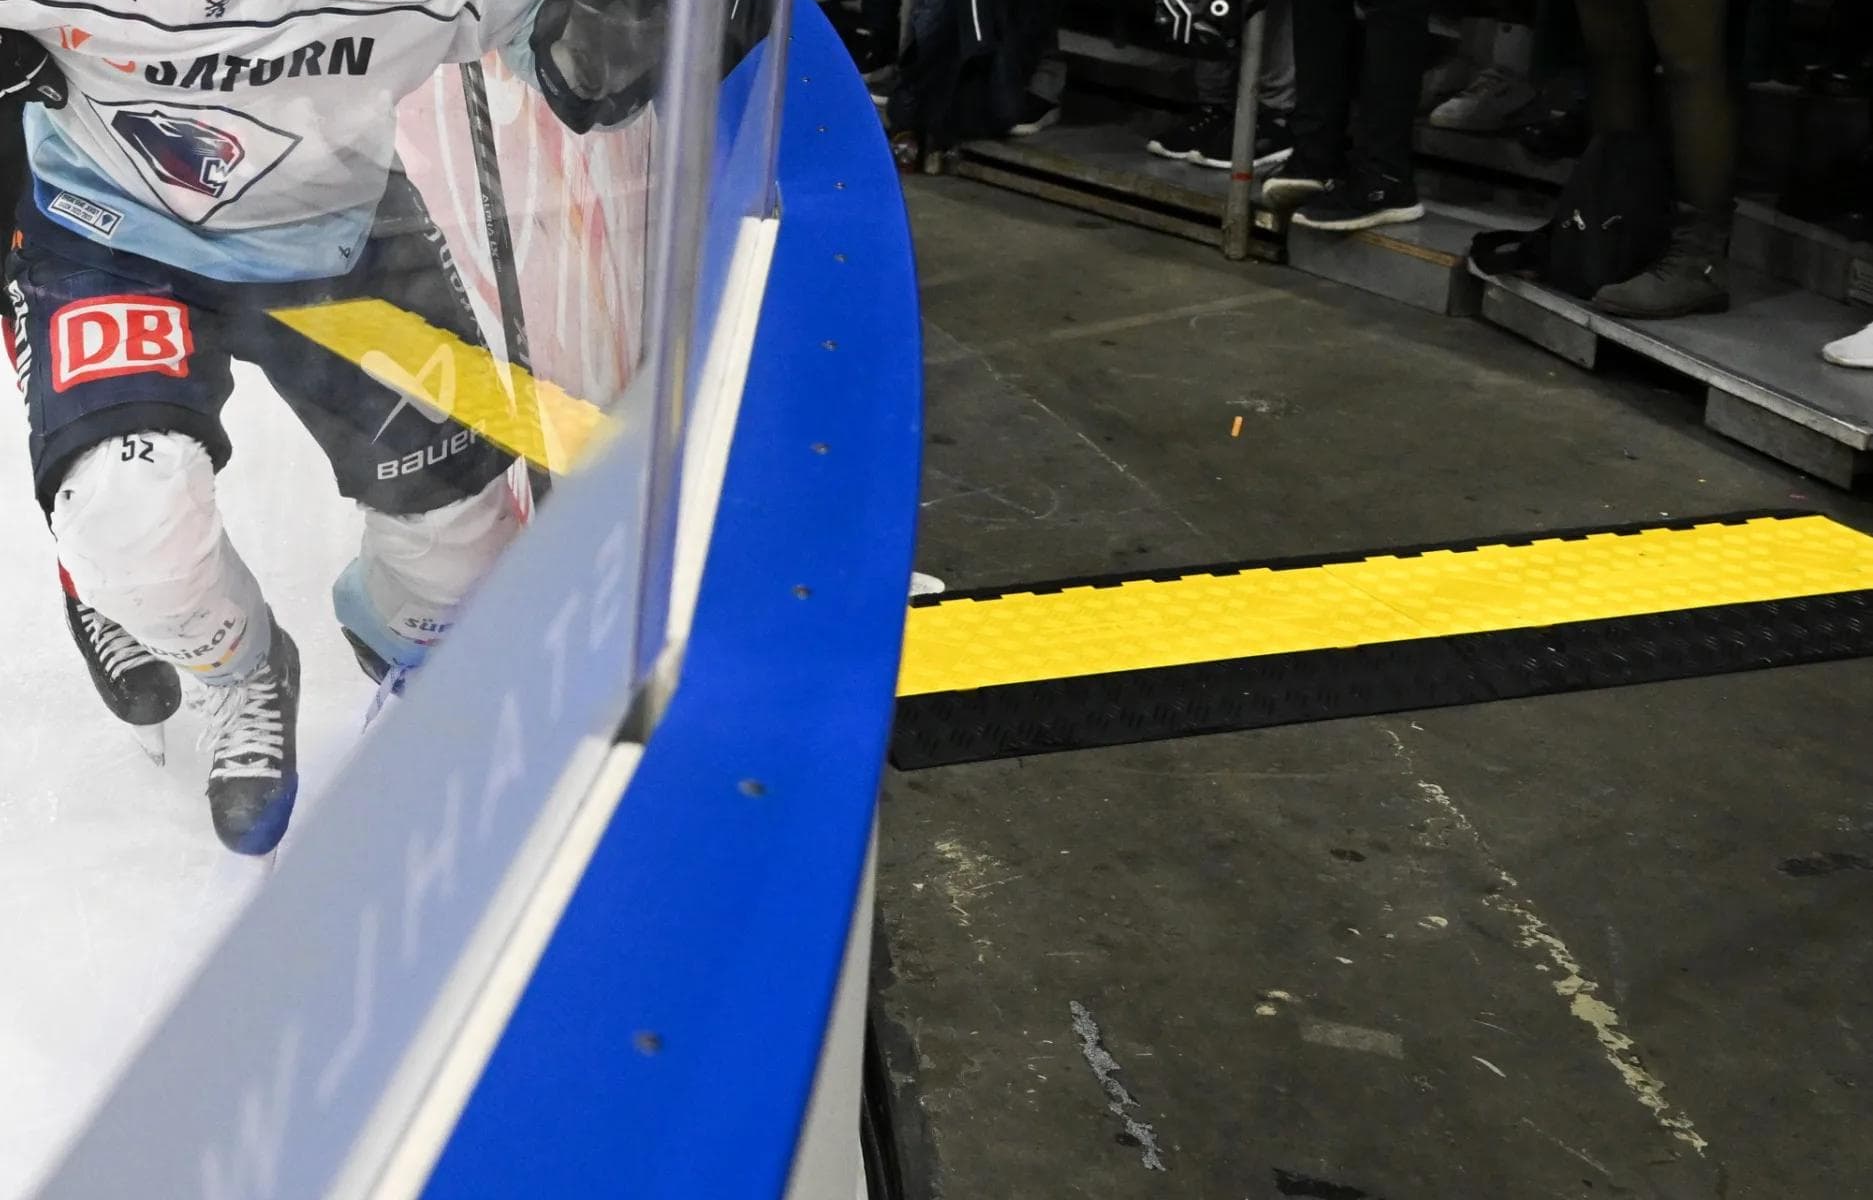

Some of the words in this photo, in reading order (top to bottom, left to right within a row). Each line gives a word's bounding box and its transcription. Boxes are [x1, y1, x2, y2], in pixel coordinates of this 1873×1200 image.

[144, 36, 376, 92] SATURN
[66, 309, 179, 374] DB
[121, 432, 155, 463] 52
[377, 418, 486, 481] BAUER
